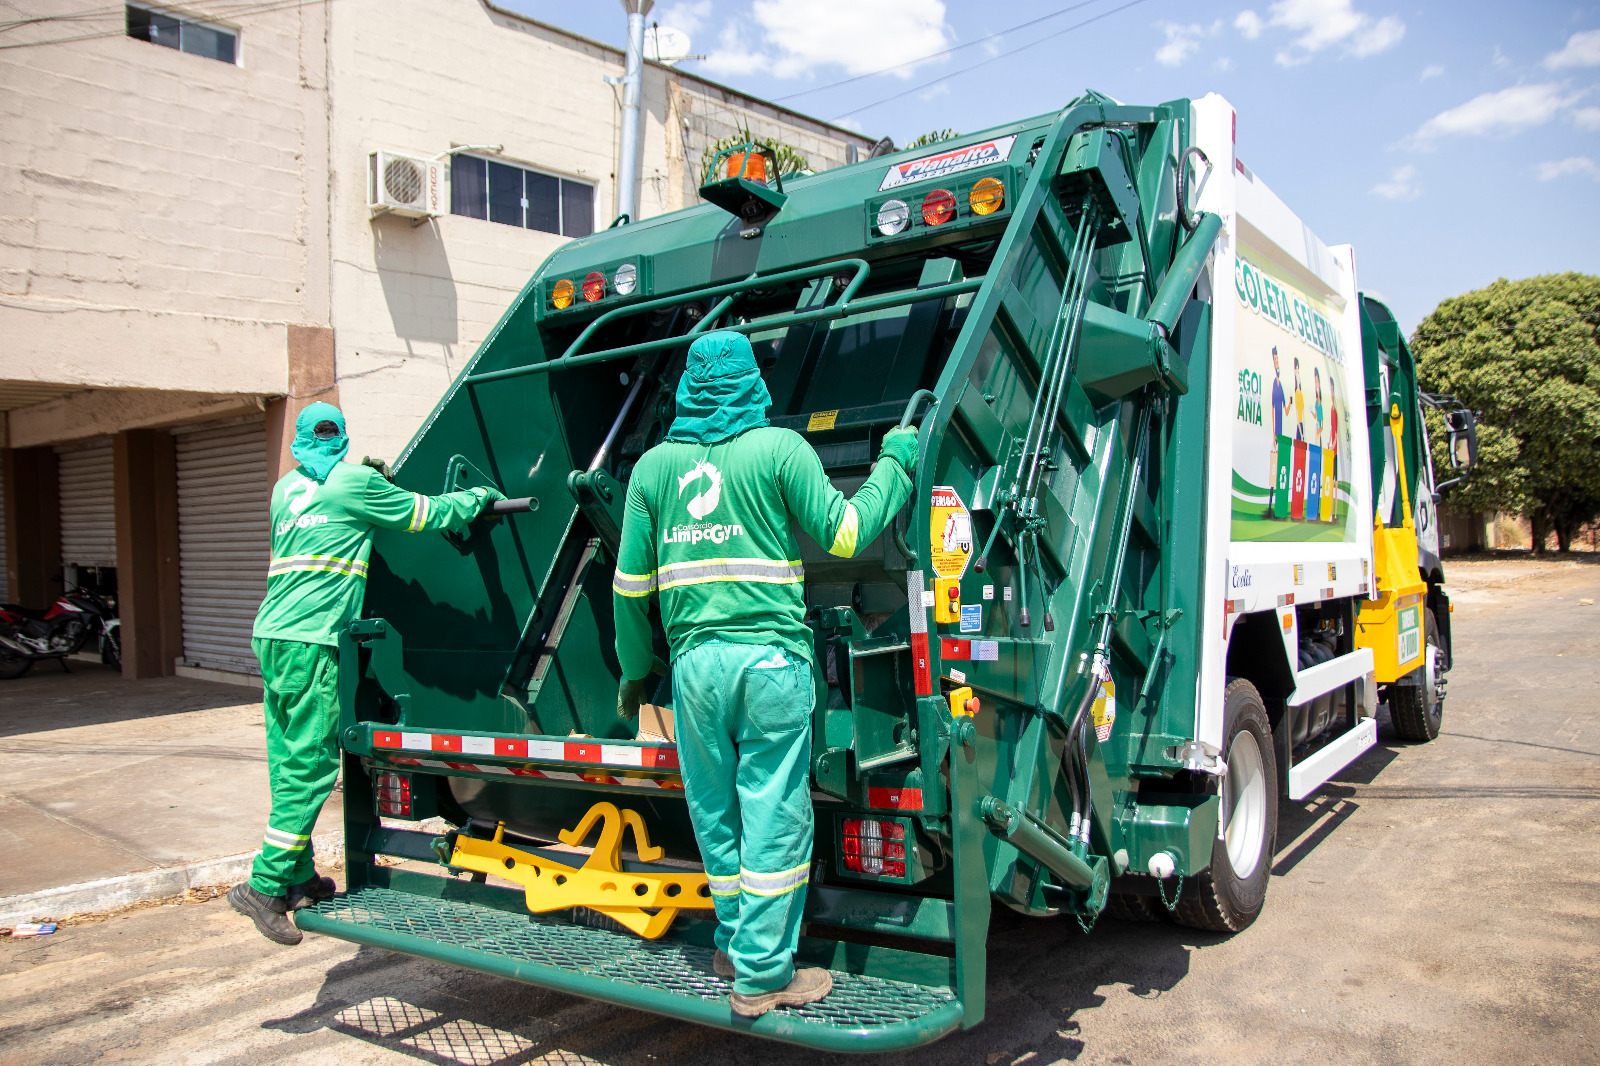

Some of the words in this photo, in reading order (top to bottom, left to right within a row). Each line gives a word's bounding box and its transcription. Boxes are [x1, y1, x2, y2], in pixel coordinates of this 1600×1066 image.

[904, 145, 996, 177] Planalto
[430, 166, 438, 211] KOMECO
[1235, 256, 1296, 334] COLETA
[1238, 368, 1262, 396] #GOI
[931, 495, 957, 507] PERIGO
[663, 524, 744, 545] LimpaGyn
